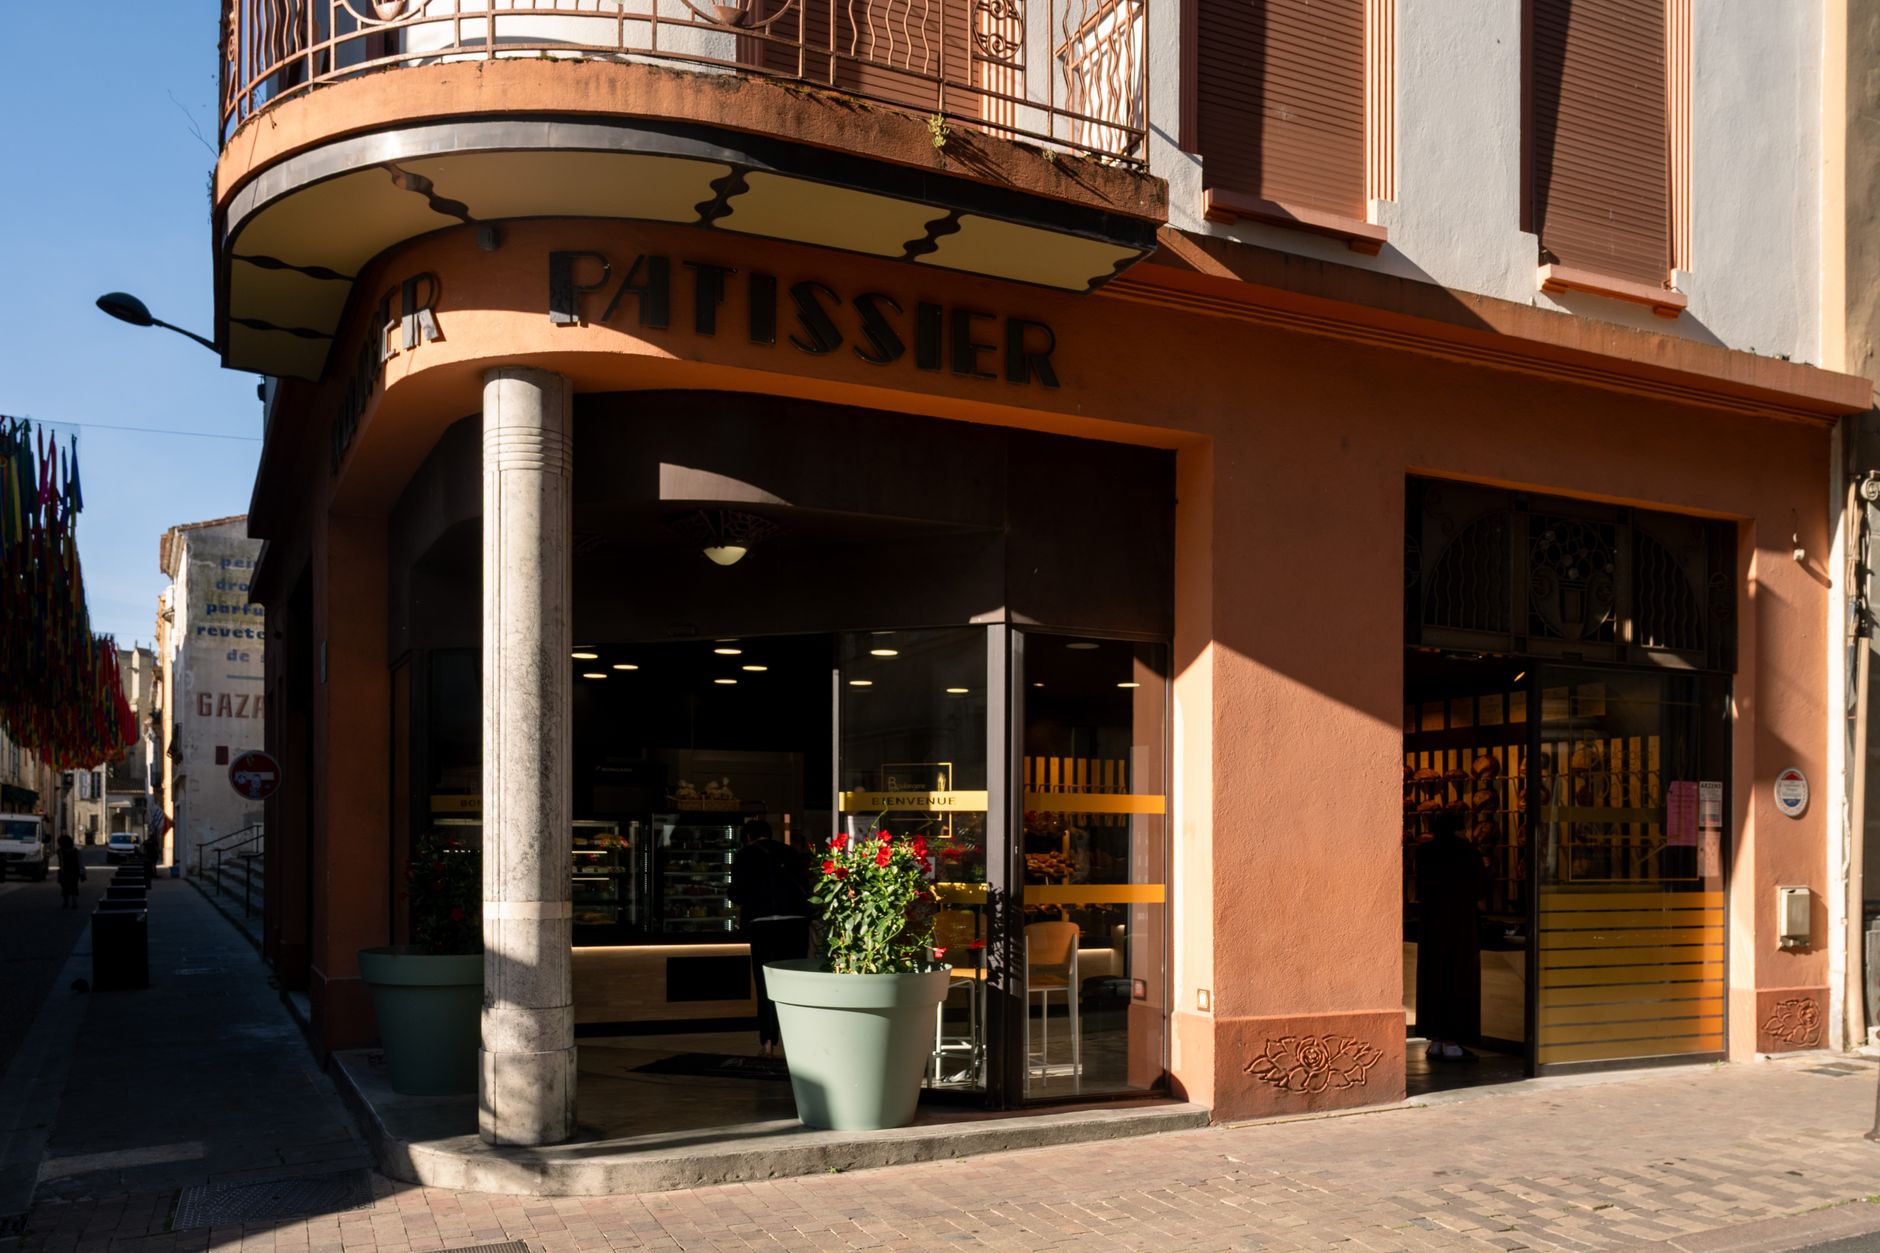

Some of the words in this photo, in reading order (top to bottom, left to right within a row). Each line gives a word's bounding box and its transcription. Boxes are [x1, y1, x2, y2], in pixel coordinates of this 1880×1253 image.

[549, 250, 1061, 389] PATISSIER
[226, 649, 250, 662] de
[871, 796, 957, 806] BIENVENUE
